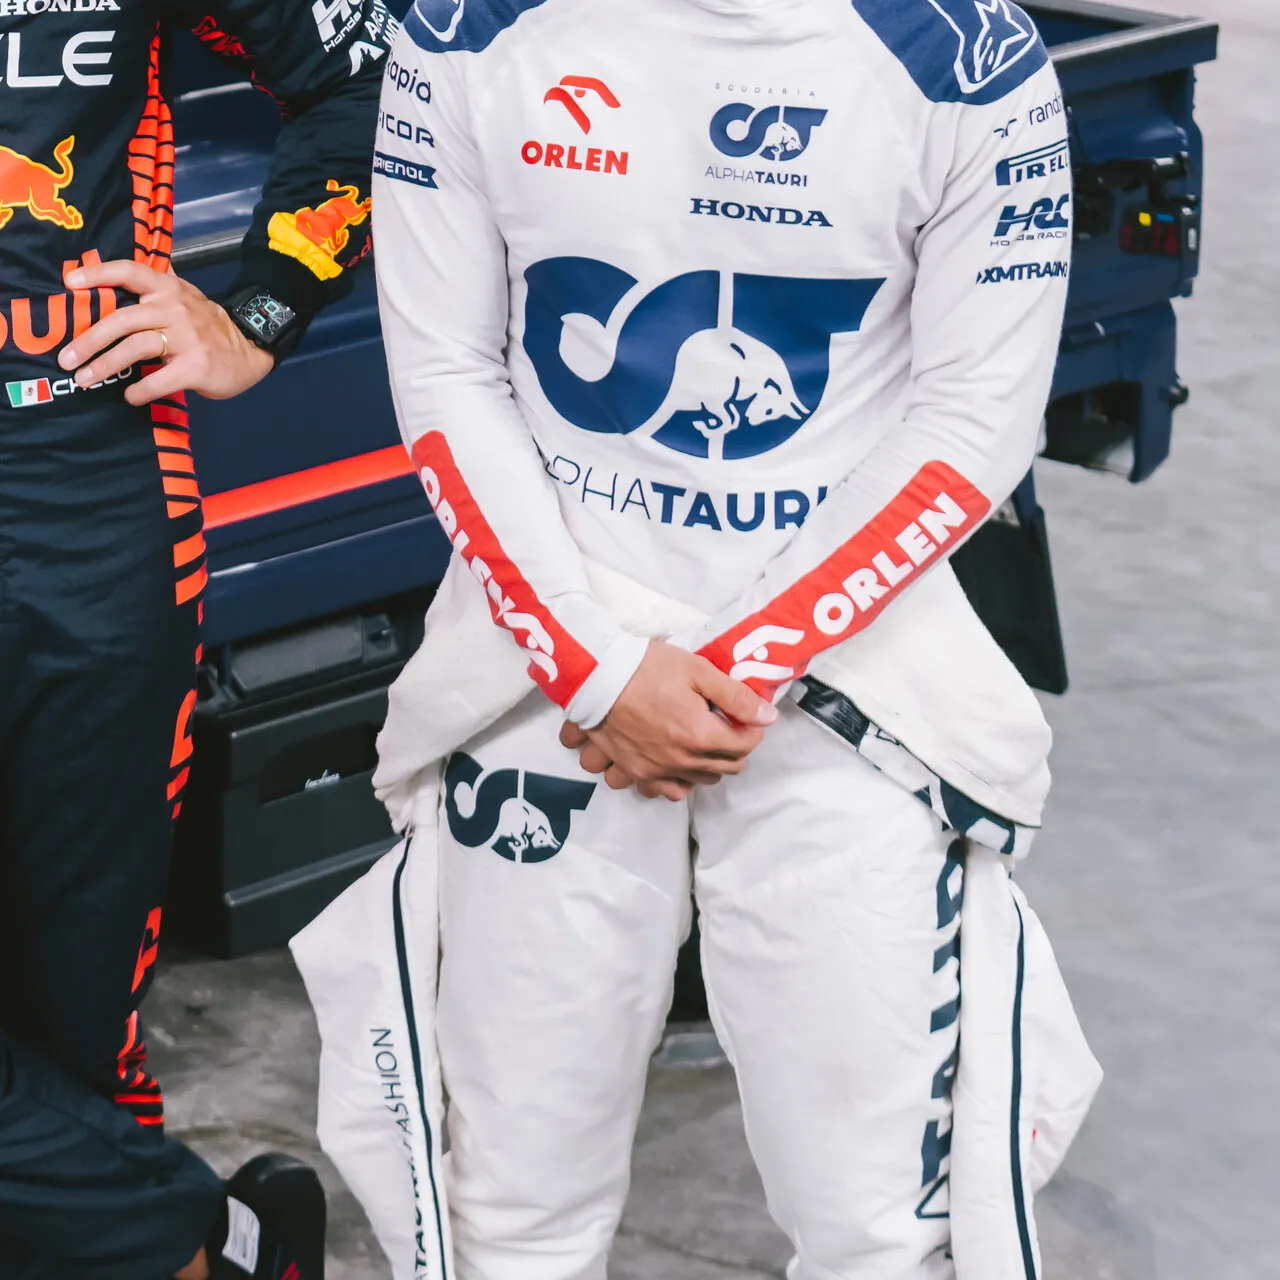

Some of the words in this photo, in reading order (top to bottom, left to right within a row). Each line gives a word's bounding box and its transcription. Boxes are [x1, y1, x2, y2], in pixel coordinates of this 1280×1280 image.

[714, 82, 816, 97] SCUDERIA
[521, 140, 629, 176] ORLEN
[704, 165, 808, 188] ALPHATAURI
[689, 197, 834, 228] HONDA
[812, 490, 971, 637] ORLEN
